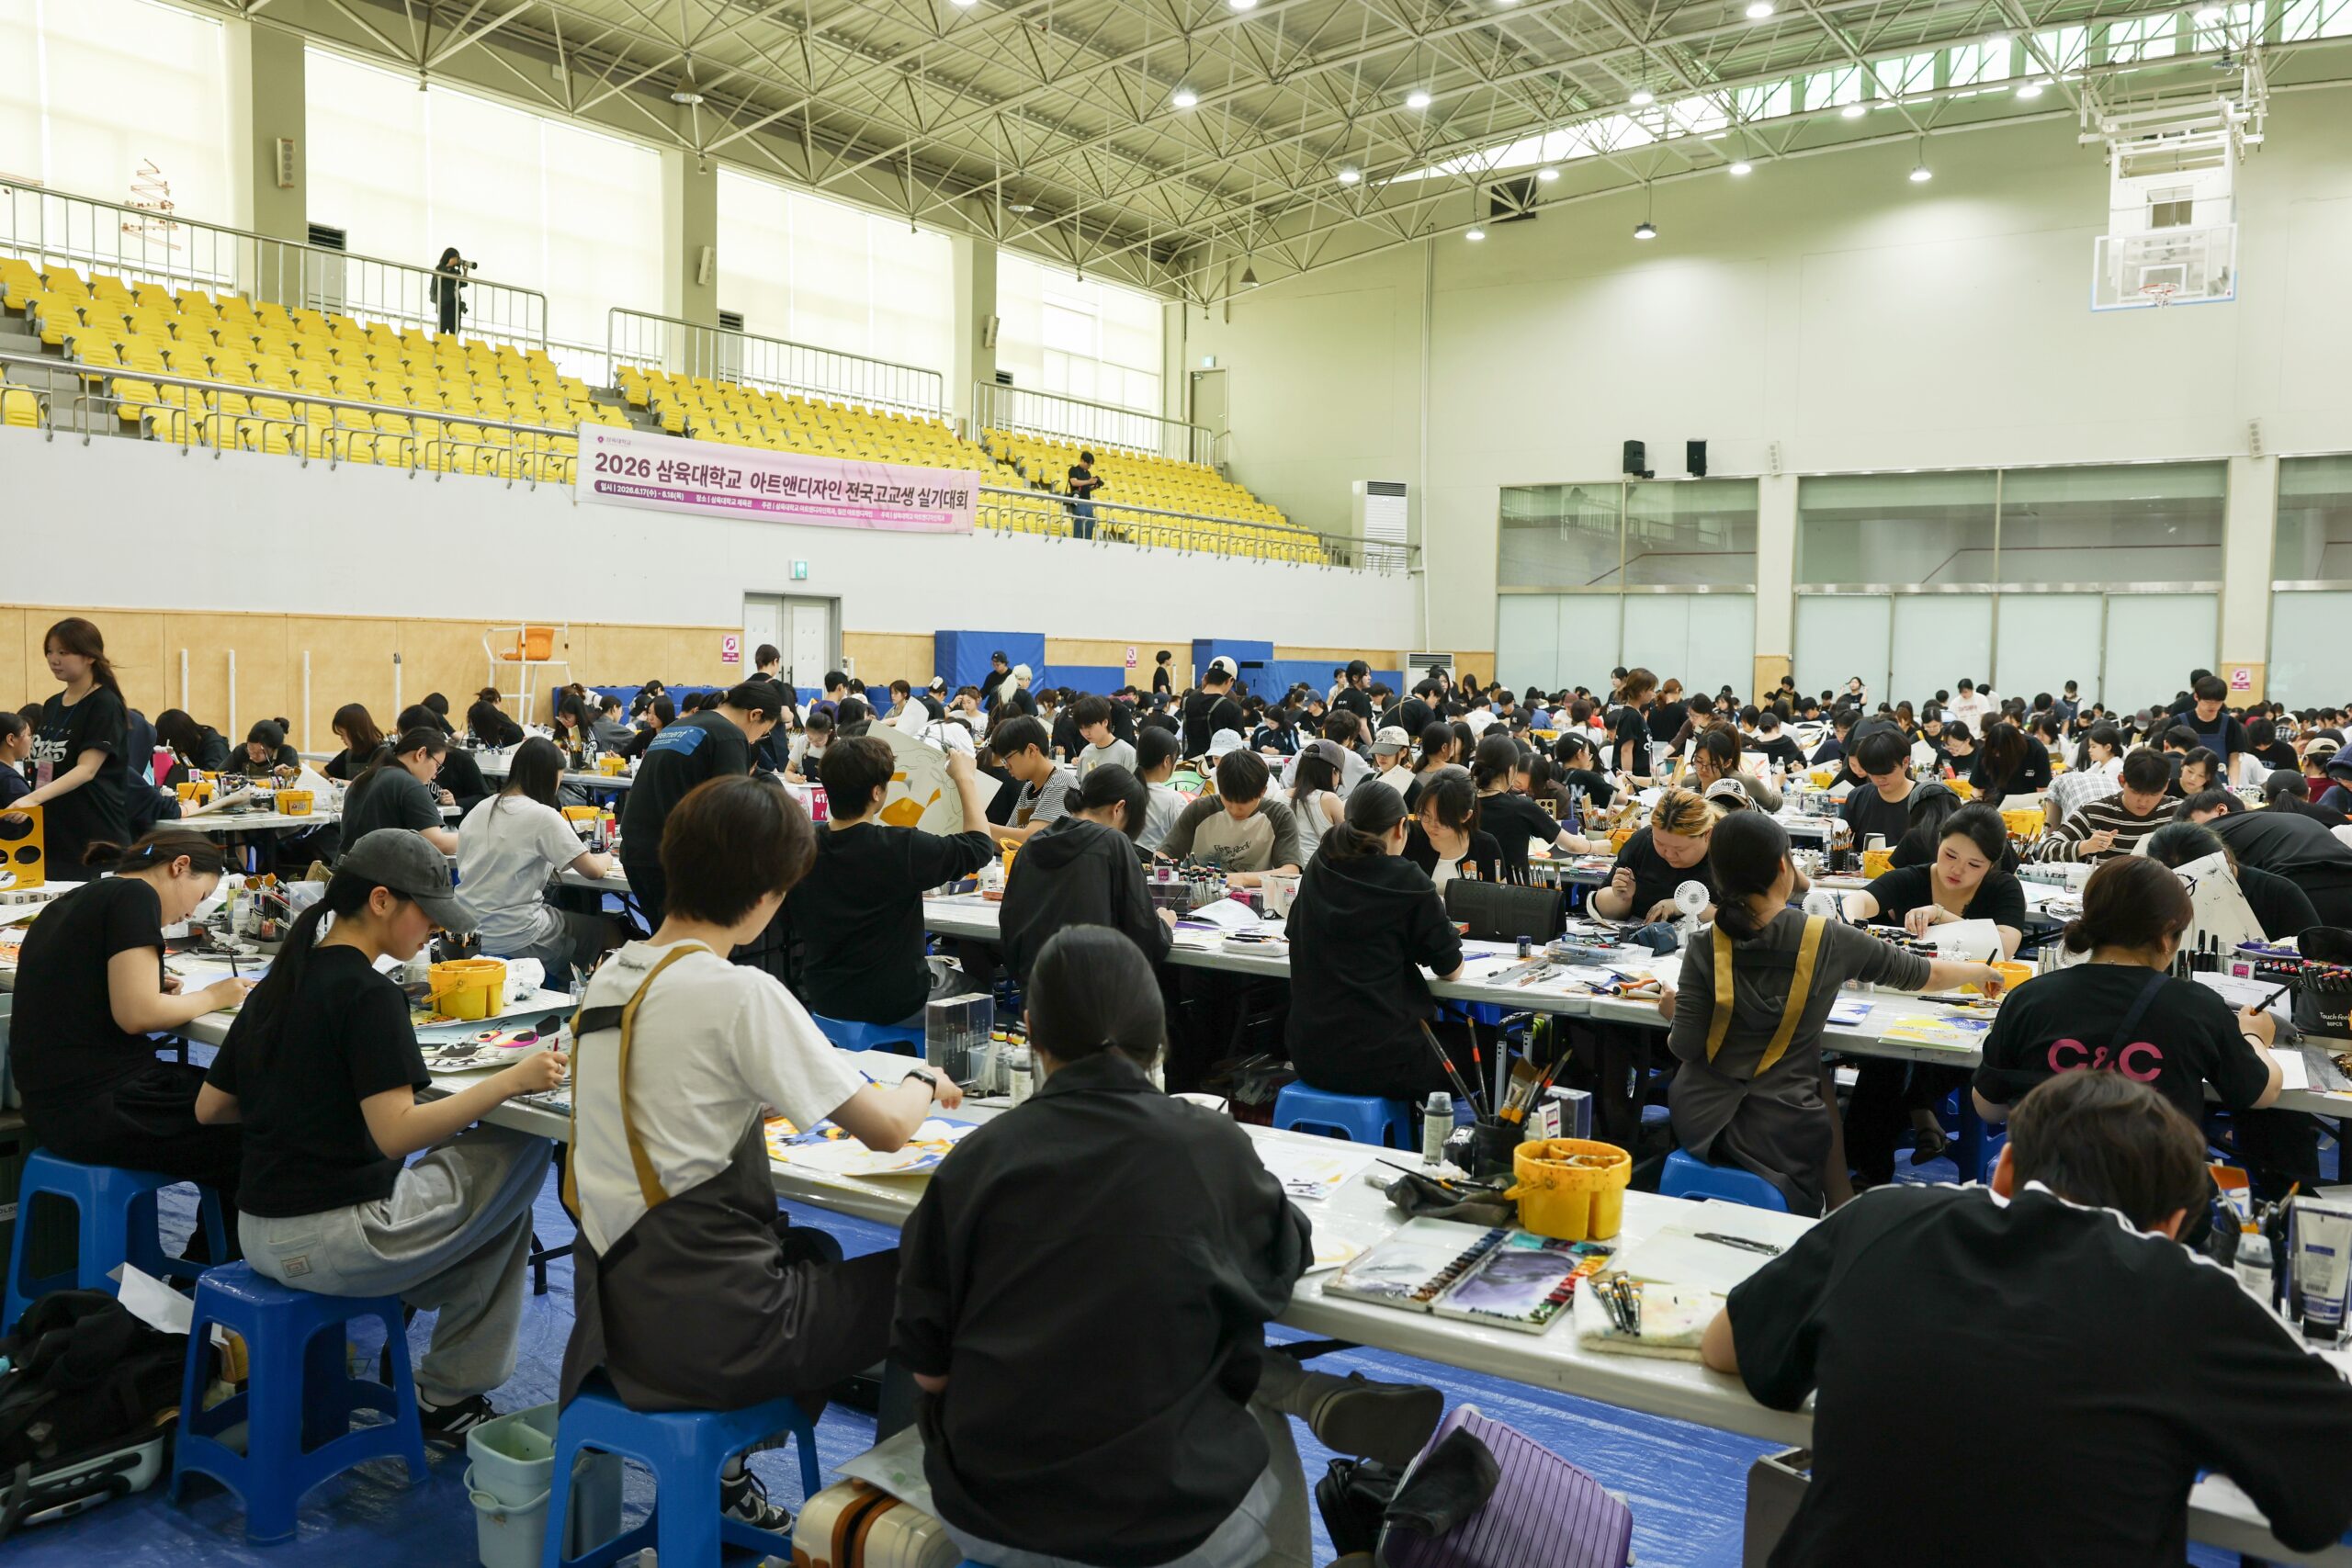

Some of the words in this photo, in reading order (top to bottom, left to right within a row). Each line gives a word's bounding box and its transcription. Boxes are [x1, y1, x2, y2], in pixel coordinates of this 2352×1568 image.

[594, 451, 651, 479] 2026
[655, 459, 742, 489] 삼육대학교
[750, 471, 842, 502] 아트앤디자인
[845, 481, 915, 507] 전국고교생
[917, 488, 969, 510] 실기대회
[600, 482, 613, 492] 일시
[616, 485, 657, 498] 2026.6.17(수)
[711, 496, 736, 507] 삼육대학교
[2319, 1011, 2337, 1021] Touch
[2048, 1038, 2163, 1082] C&C
